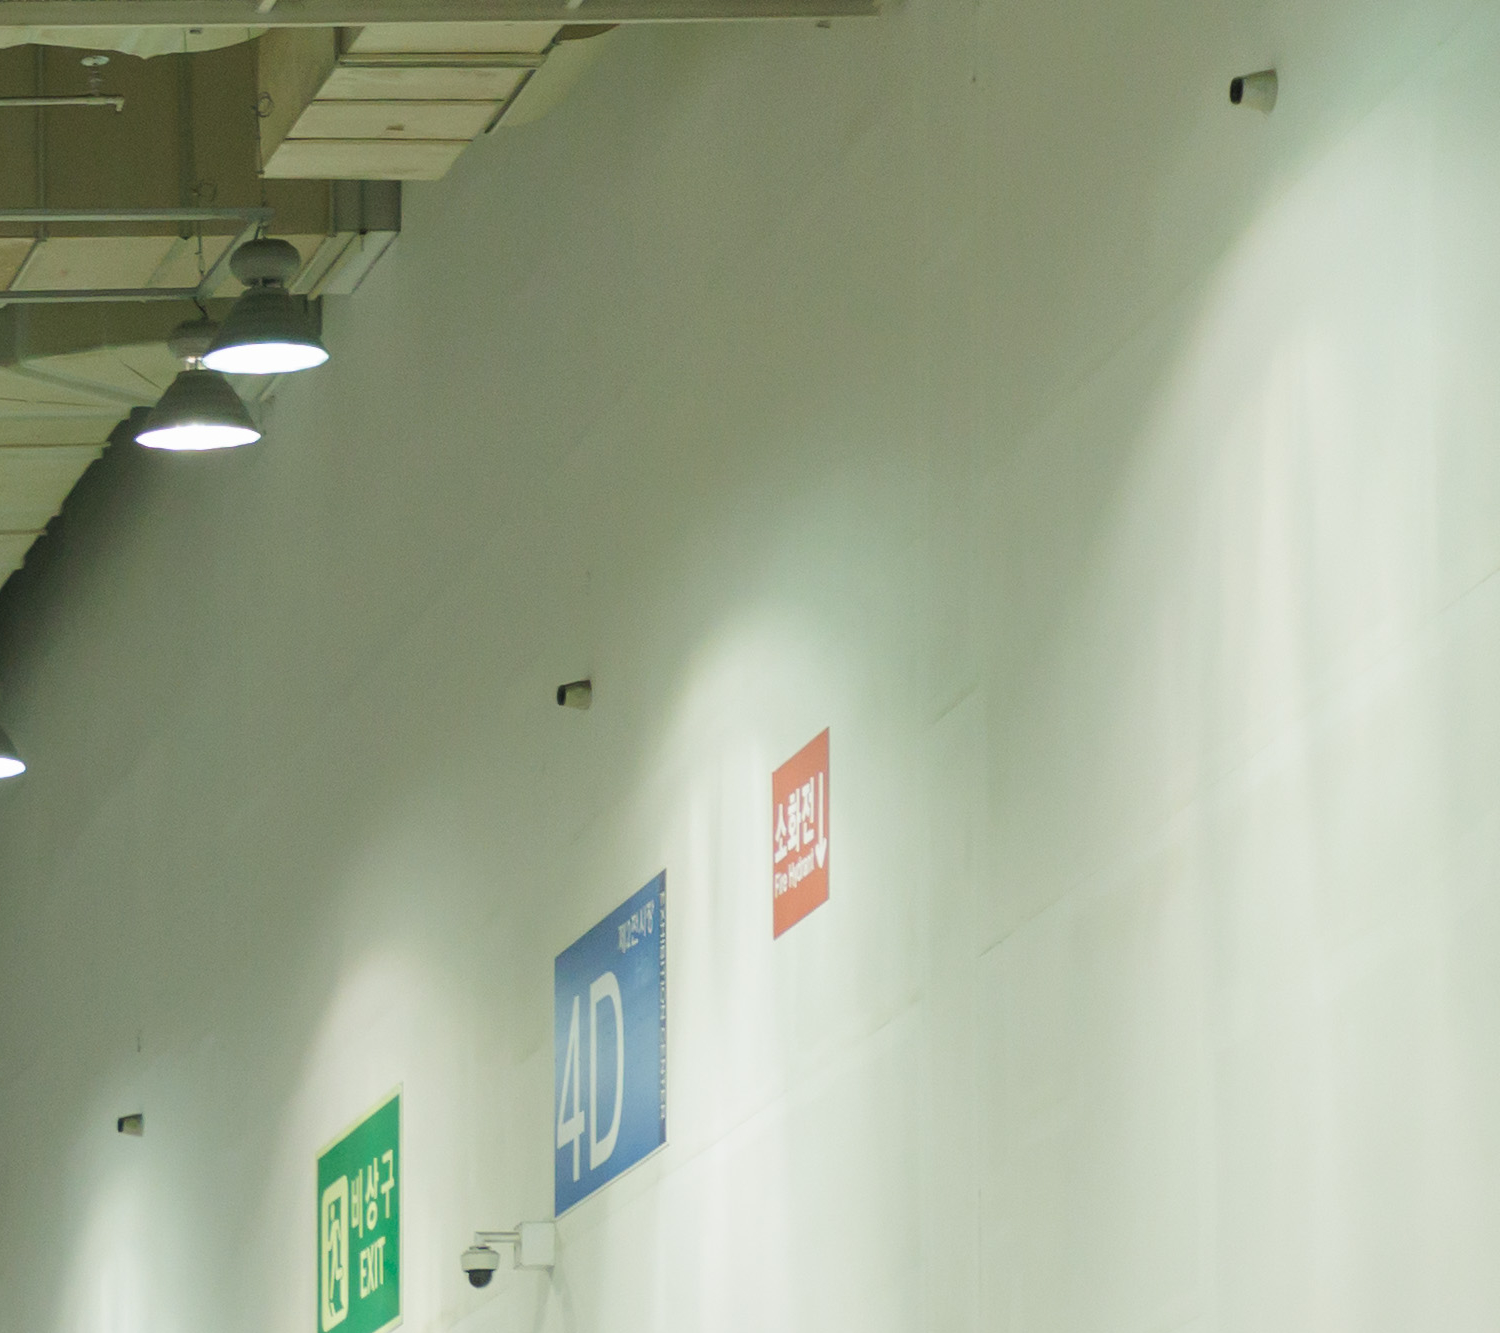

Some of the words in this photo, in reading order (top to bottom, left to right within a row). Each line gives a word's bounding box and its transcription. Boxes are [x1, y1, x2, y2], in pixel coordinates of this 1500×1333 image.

[775, 777, 814, 863] 소화전
[556, 971, 625, 1183] 4D
[351, 1149, 395, 1239] 비상구
[359, 1236, 386, 1300] EXIT
